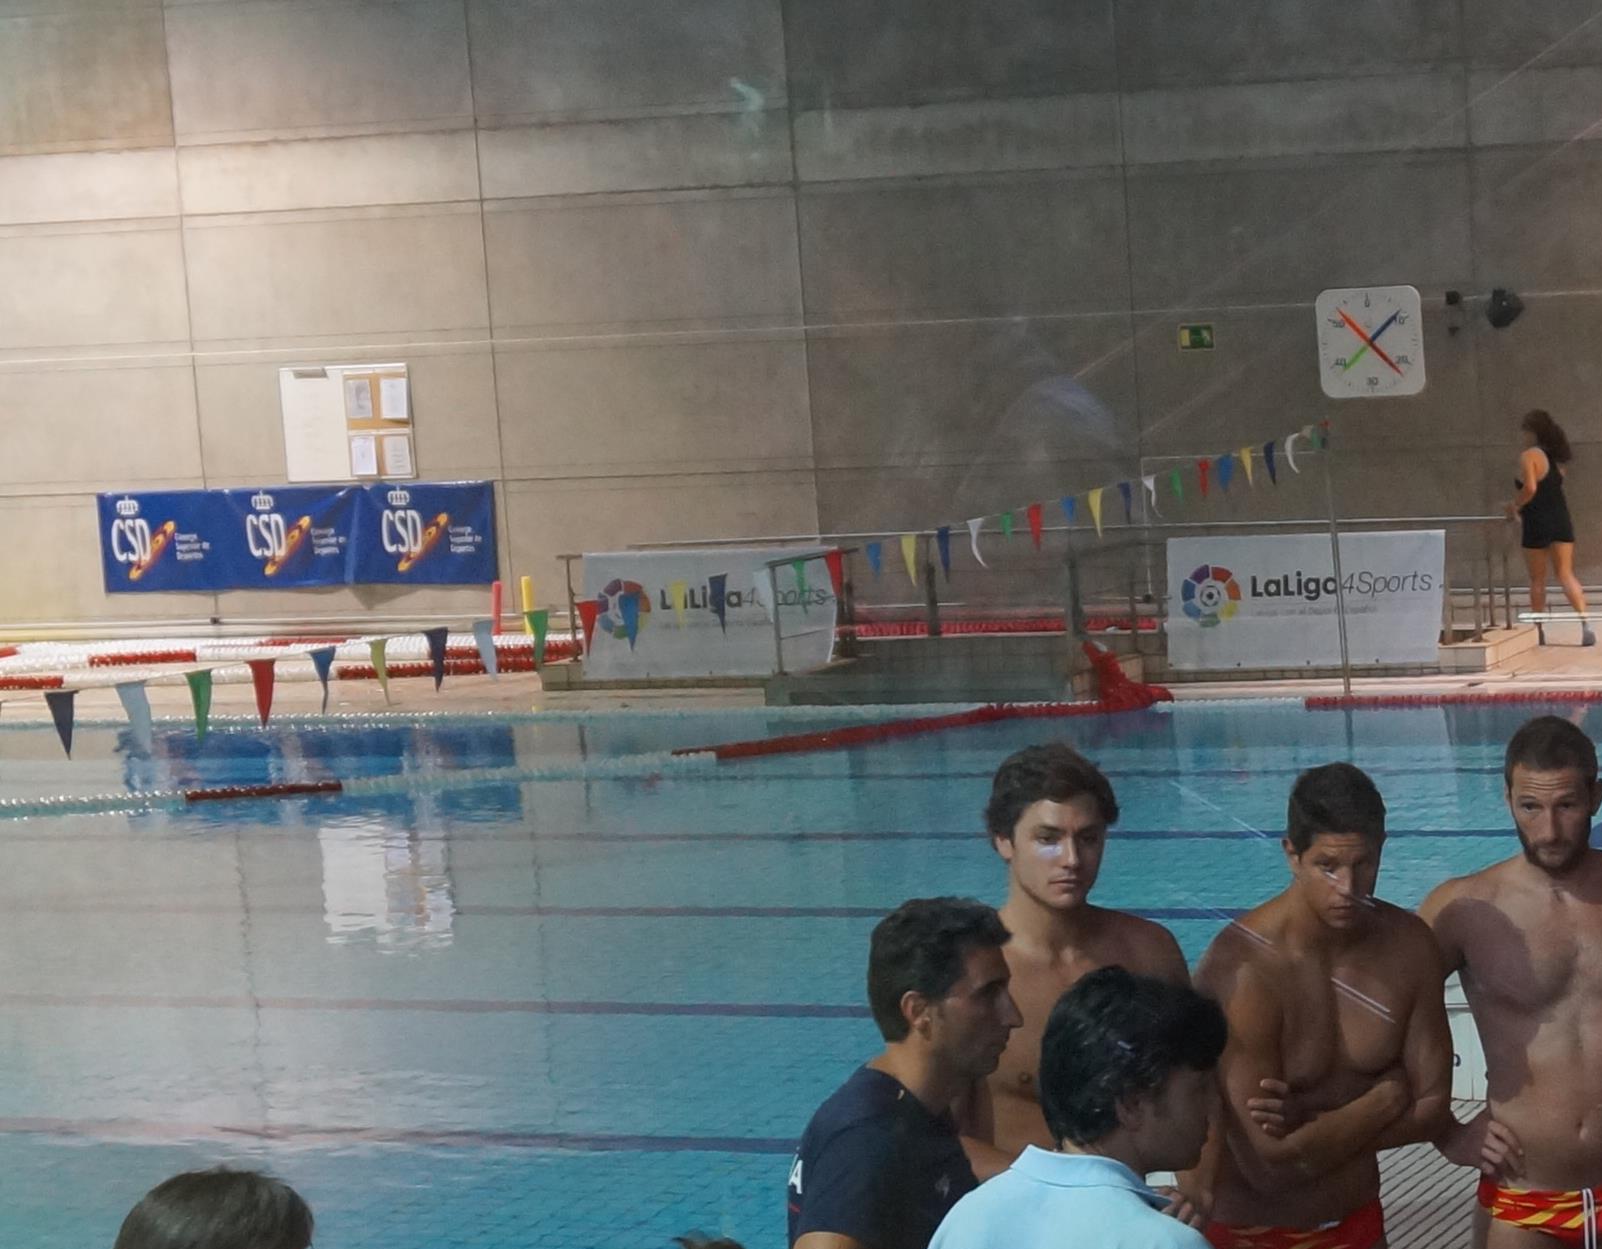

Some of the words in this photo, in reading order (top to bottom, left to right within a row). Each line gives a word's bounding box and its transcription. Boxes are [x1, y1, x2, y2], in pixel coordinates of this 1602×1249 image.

[111, 518, 151, 563] CSD
[245, 512, 287, 558] CSD
[381, 509, 423, 554] CSD
